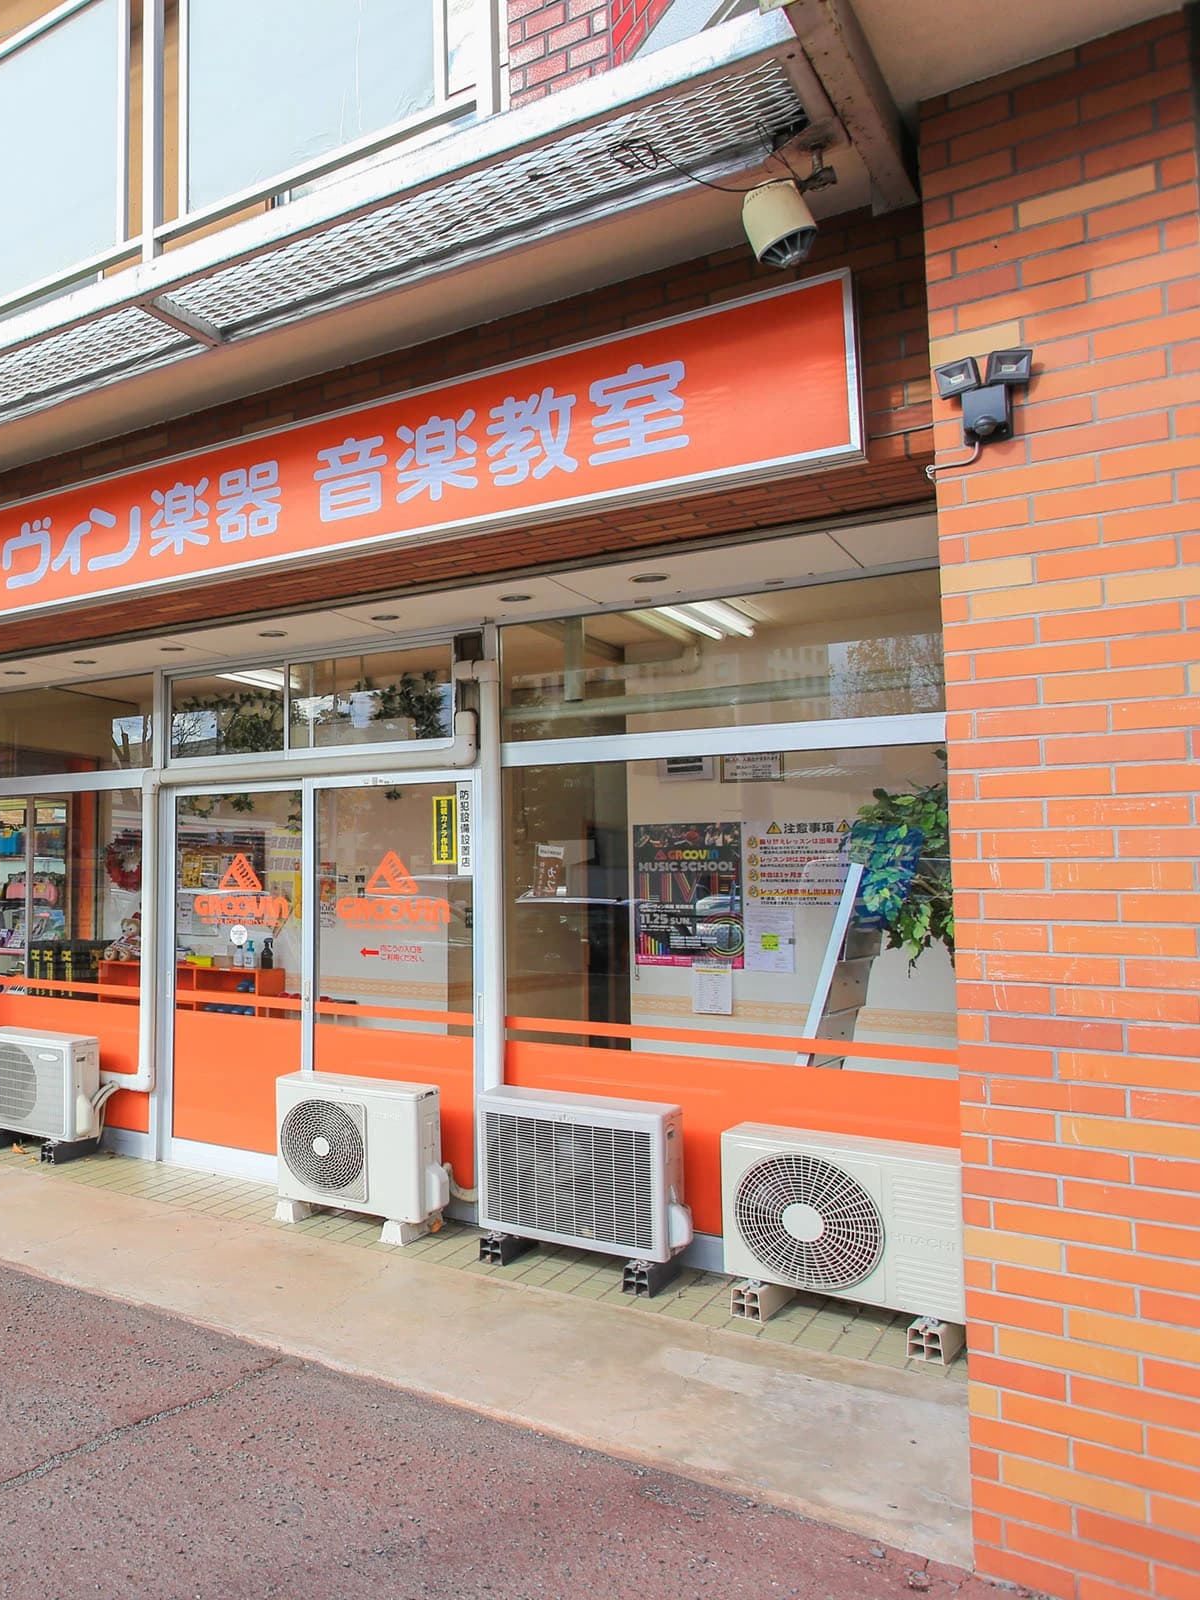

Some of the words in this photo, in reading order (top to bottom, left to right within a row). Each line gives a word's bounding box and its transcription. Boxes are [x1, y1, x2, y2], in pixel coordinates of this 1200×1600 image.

[312, 359, 691, 523] 音楽教室
[459, 789, 471, 868] 防犯設備設置店
[783, 822, 835, 834] 注意事項
[638, 861, 678, 872] MUSIC
[680, 860, 736, 872] SCHOOL
[639, 872, 737, 903] LIVE
[194, 894, 290, 920] GROOVIN
[336, 897, 450, 924] GROOVIN
[640, 913, 669, 925] 11.25
